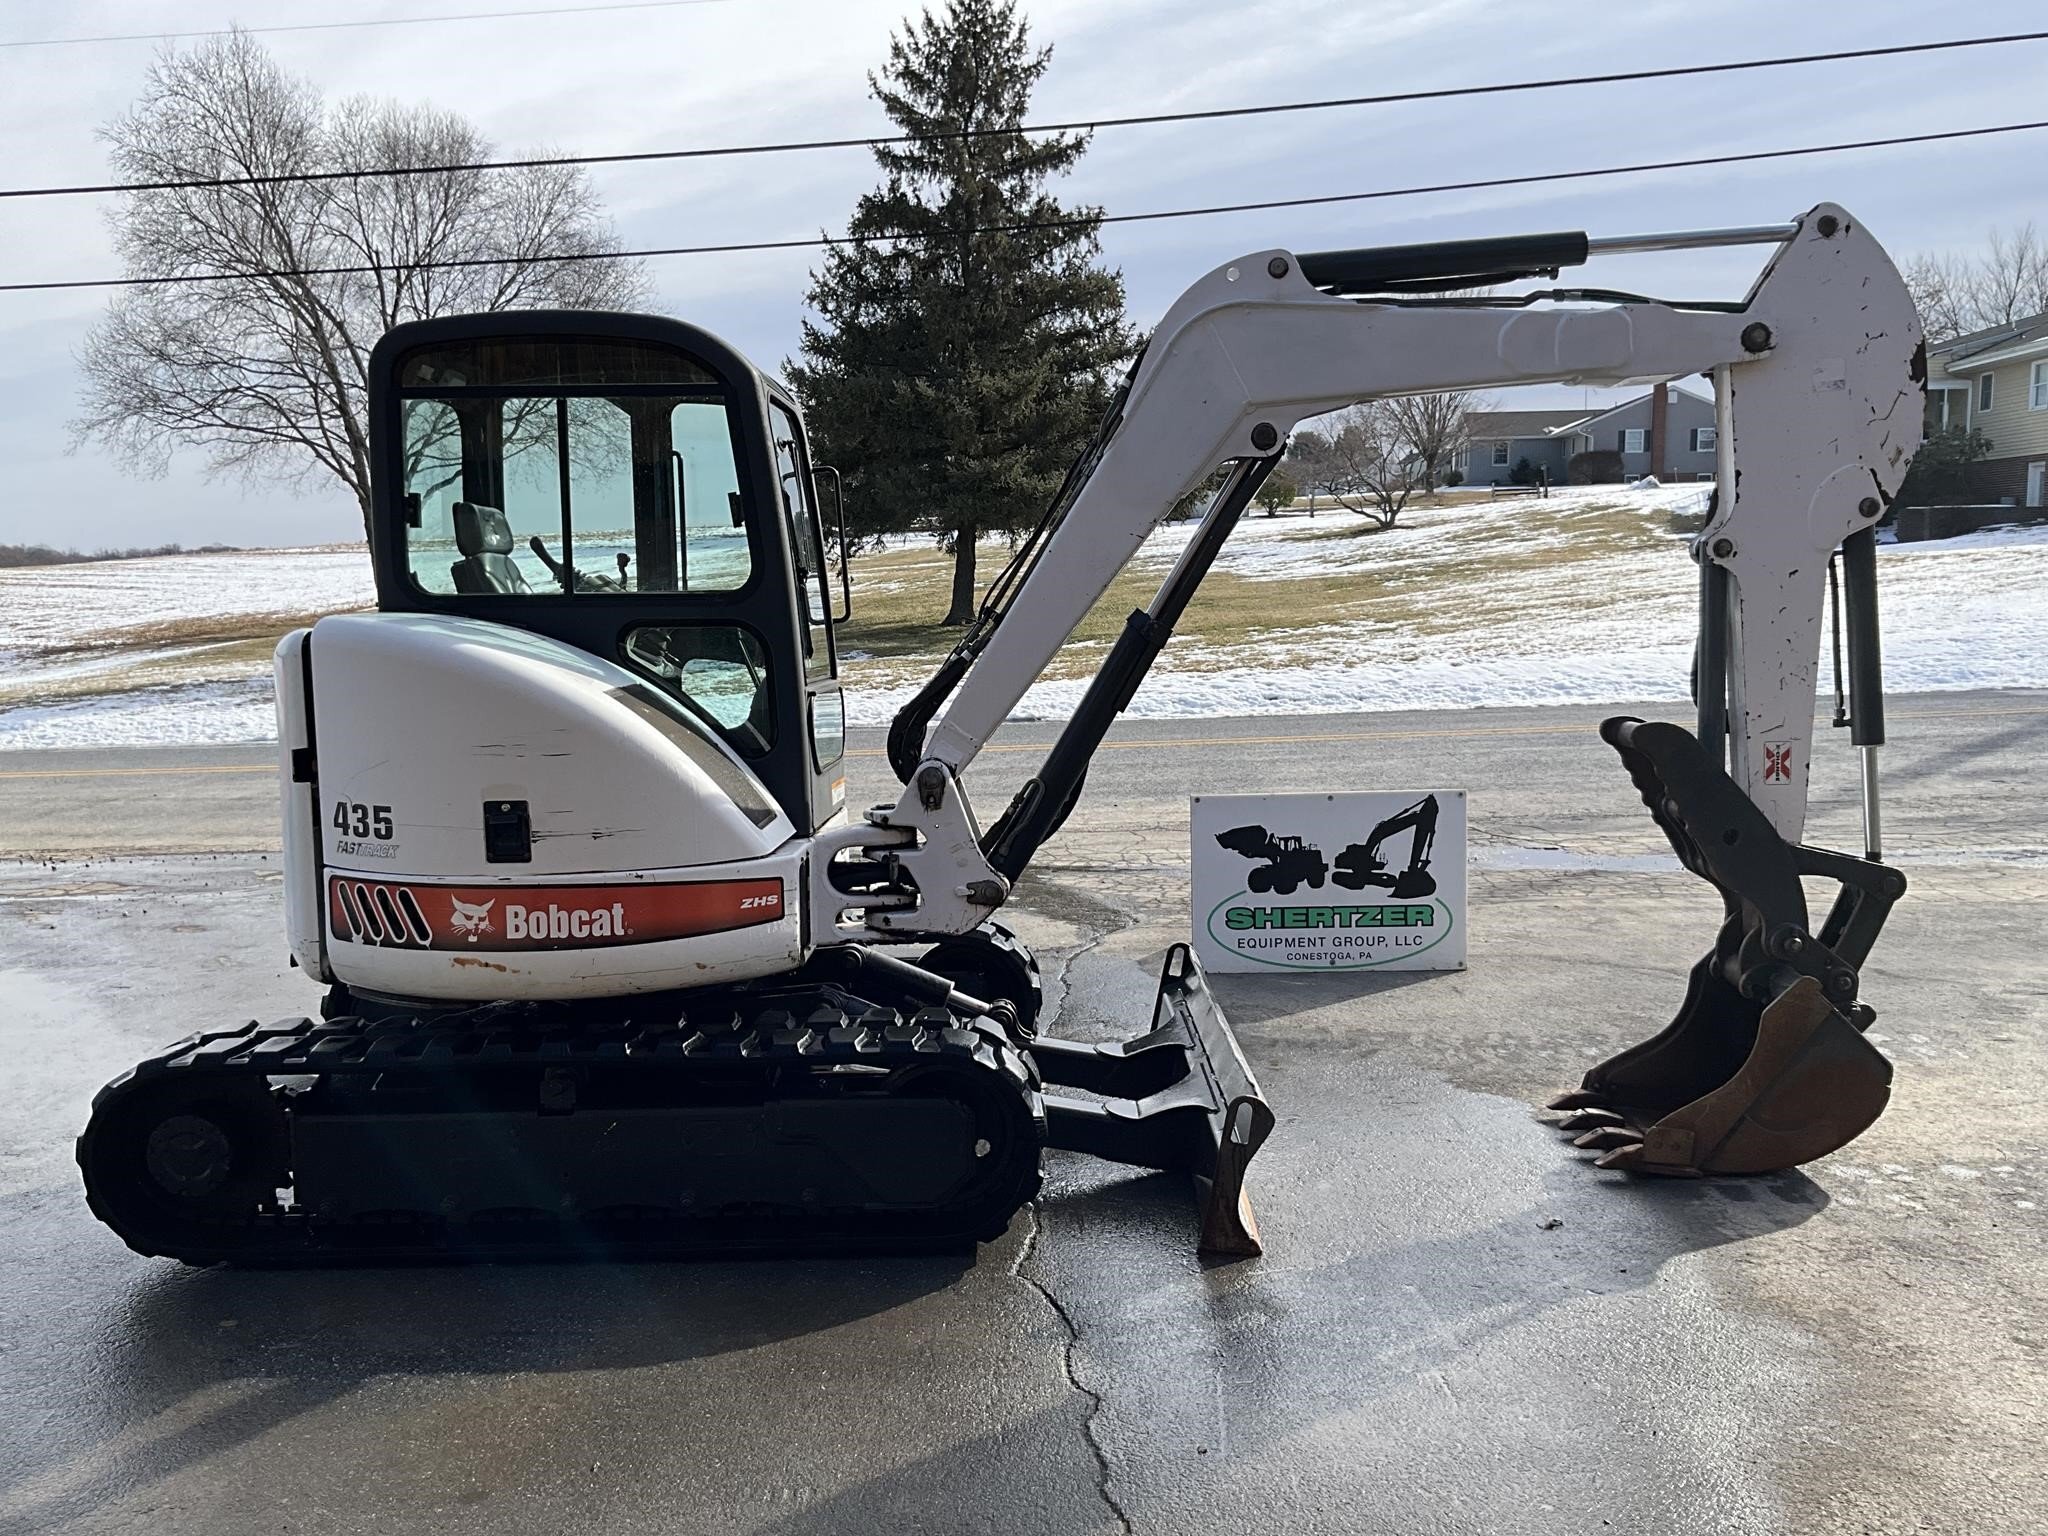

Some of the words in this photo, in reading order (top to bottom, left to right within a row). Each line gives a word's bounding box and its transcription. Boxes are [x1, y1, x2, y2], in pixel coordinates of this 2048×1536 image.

[333, 801, 393, 840] 435
[740, 894, 779, 909] ZHS
[505, 903, 625, 939] Bobcat
[1225, 904, 1435, 930] SHERTZER
[1237, 936, 1327, 949] EQUIPMENT
[1332, 936, 1389, 948] GROUP,
[1395, 935, 1423, 946] LLC
[1286, 952, 1355, 961] CONESTOGA,
[1359, 951, 1373, 960] PA
